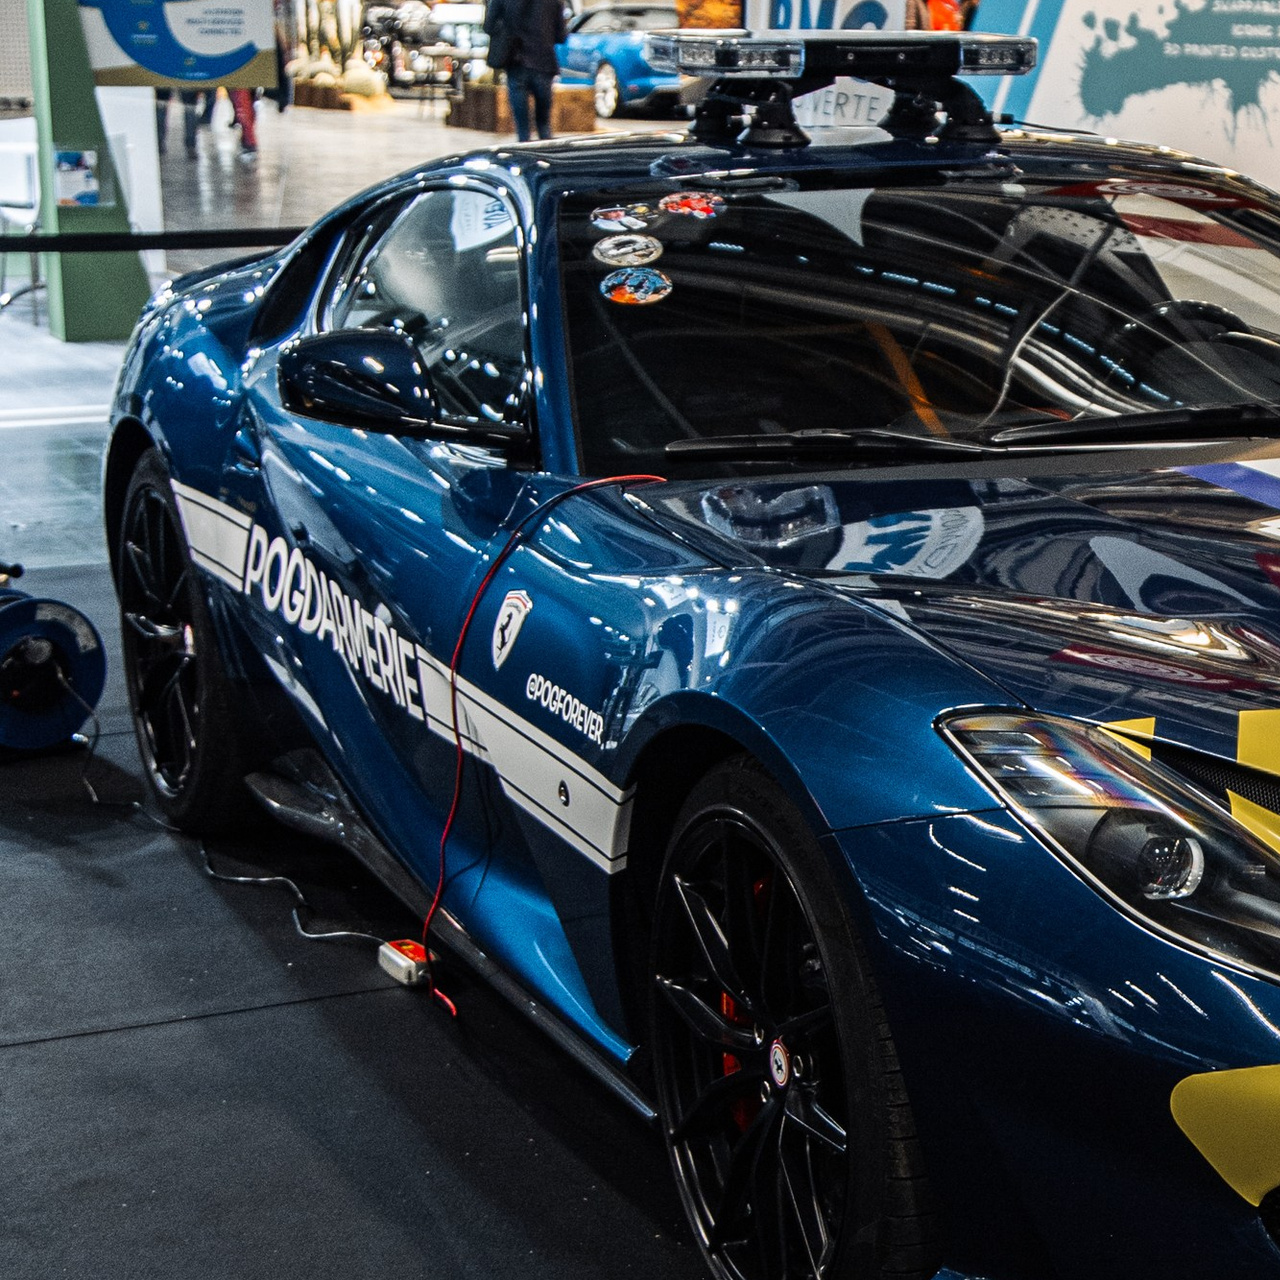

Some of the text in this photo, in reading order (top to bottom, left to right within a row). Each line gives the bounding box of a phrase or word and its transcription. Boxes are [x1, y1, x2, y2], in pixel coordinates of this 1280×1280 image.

[1183, 43, 1238, 58] PRINTED
[244, 523, 425, 721] POGDARMERIE
[526, 673, 604, 745] @POGFOREVER
